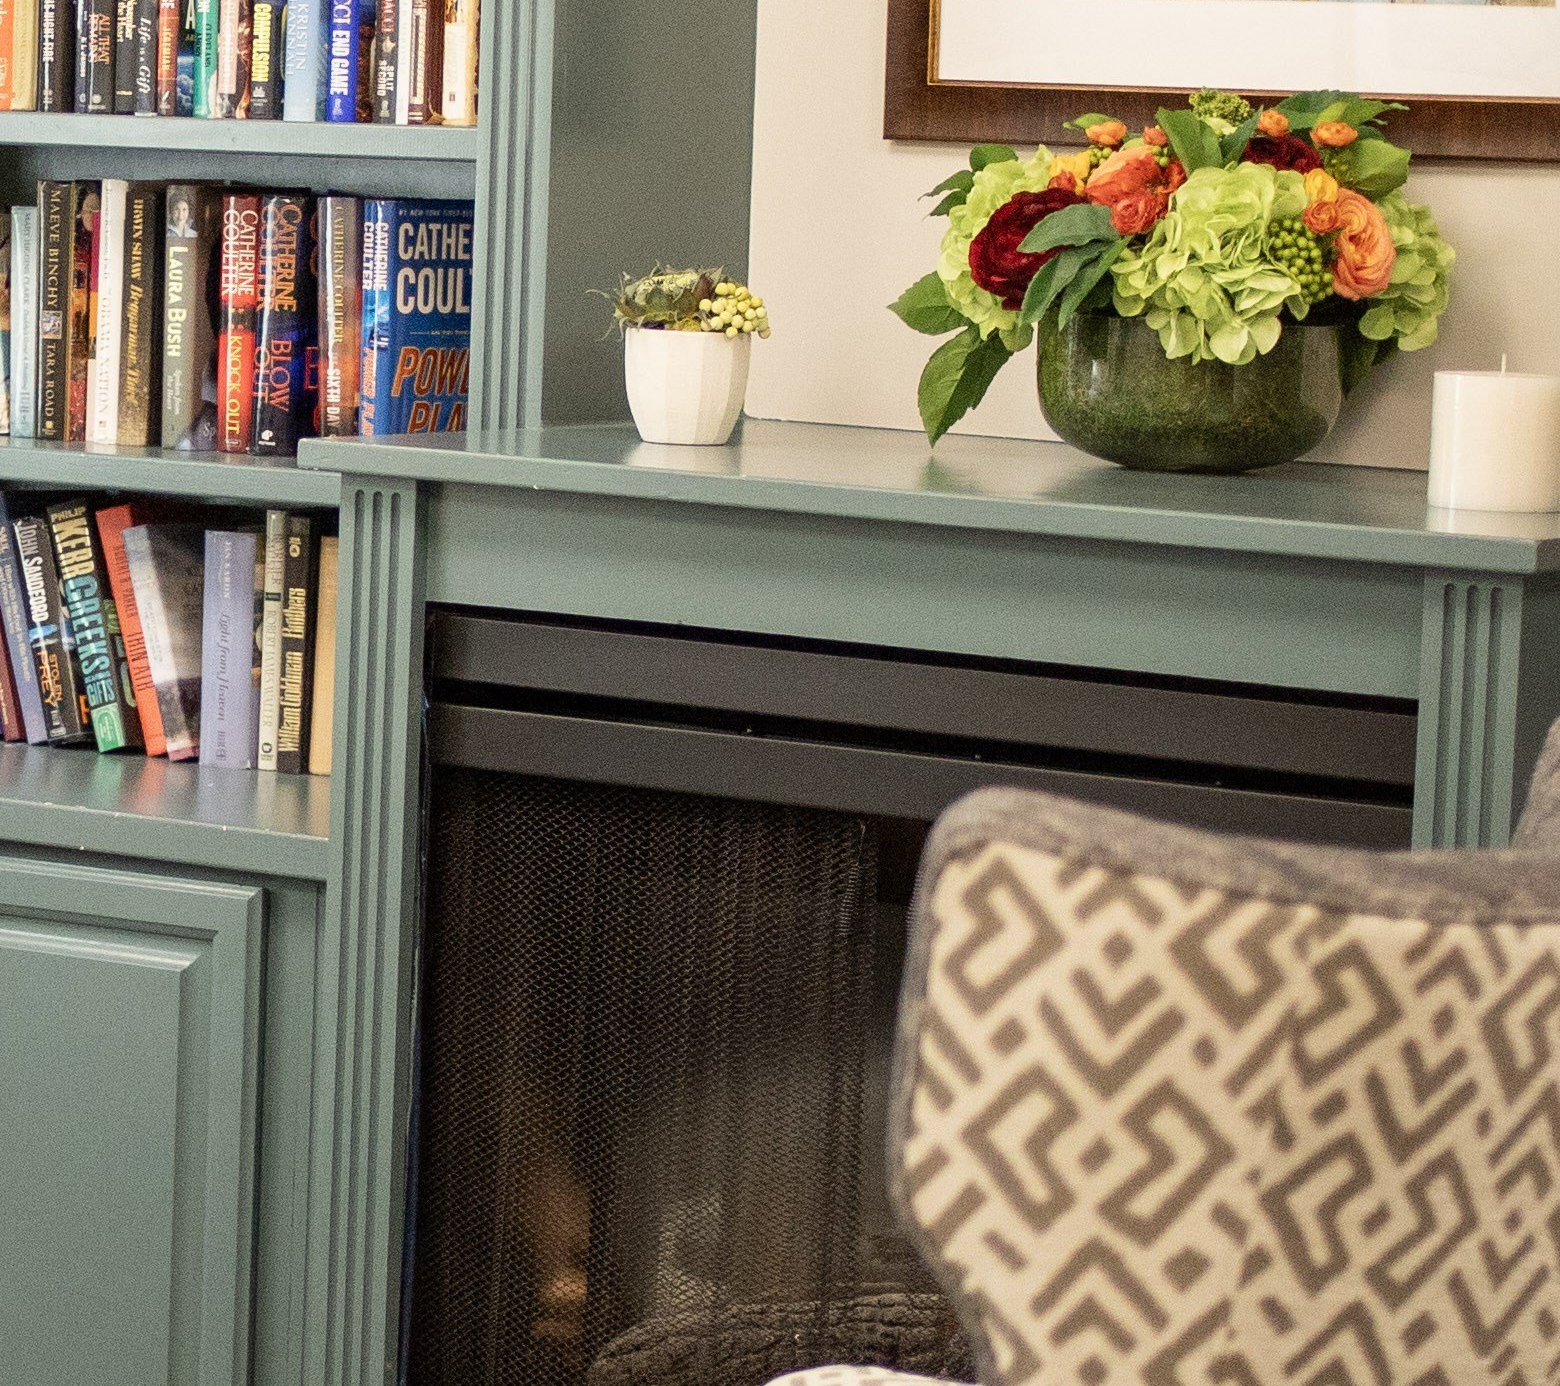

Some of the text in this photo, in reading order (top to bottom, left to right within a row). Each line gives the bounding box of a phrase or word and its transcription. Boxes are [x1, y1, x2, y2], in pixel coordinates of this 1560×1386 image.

[251, 3, 272, 83] COMPULSION
[295, 2, 310, 71] KRISTIN
[330, 59, 349, 96] GAME
[331, 29, 351, 58] END
[236, 210, 259, 297] CATHERINE
[40, 189, 63, 417] MAEVE BINCHY TARA ROAD
[166, 246, 189, 358] LAURA BUSH
[225, 335, 244, 435] KNOCK OUT
[269, 340, 293, 412] BLOW
[19, 523, 50, 623] JOHN SANDFORD
[51, 517, 116, 673] KERR GREEKS
